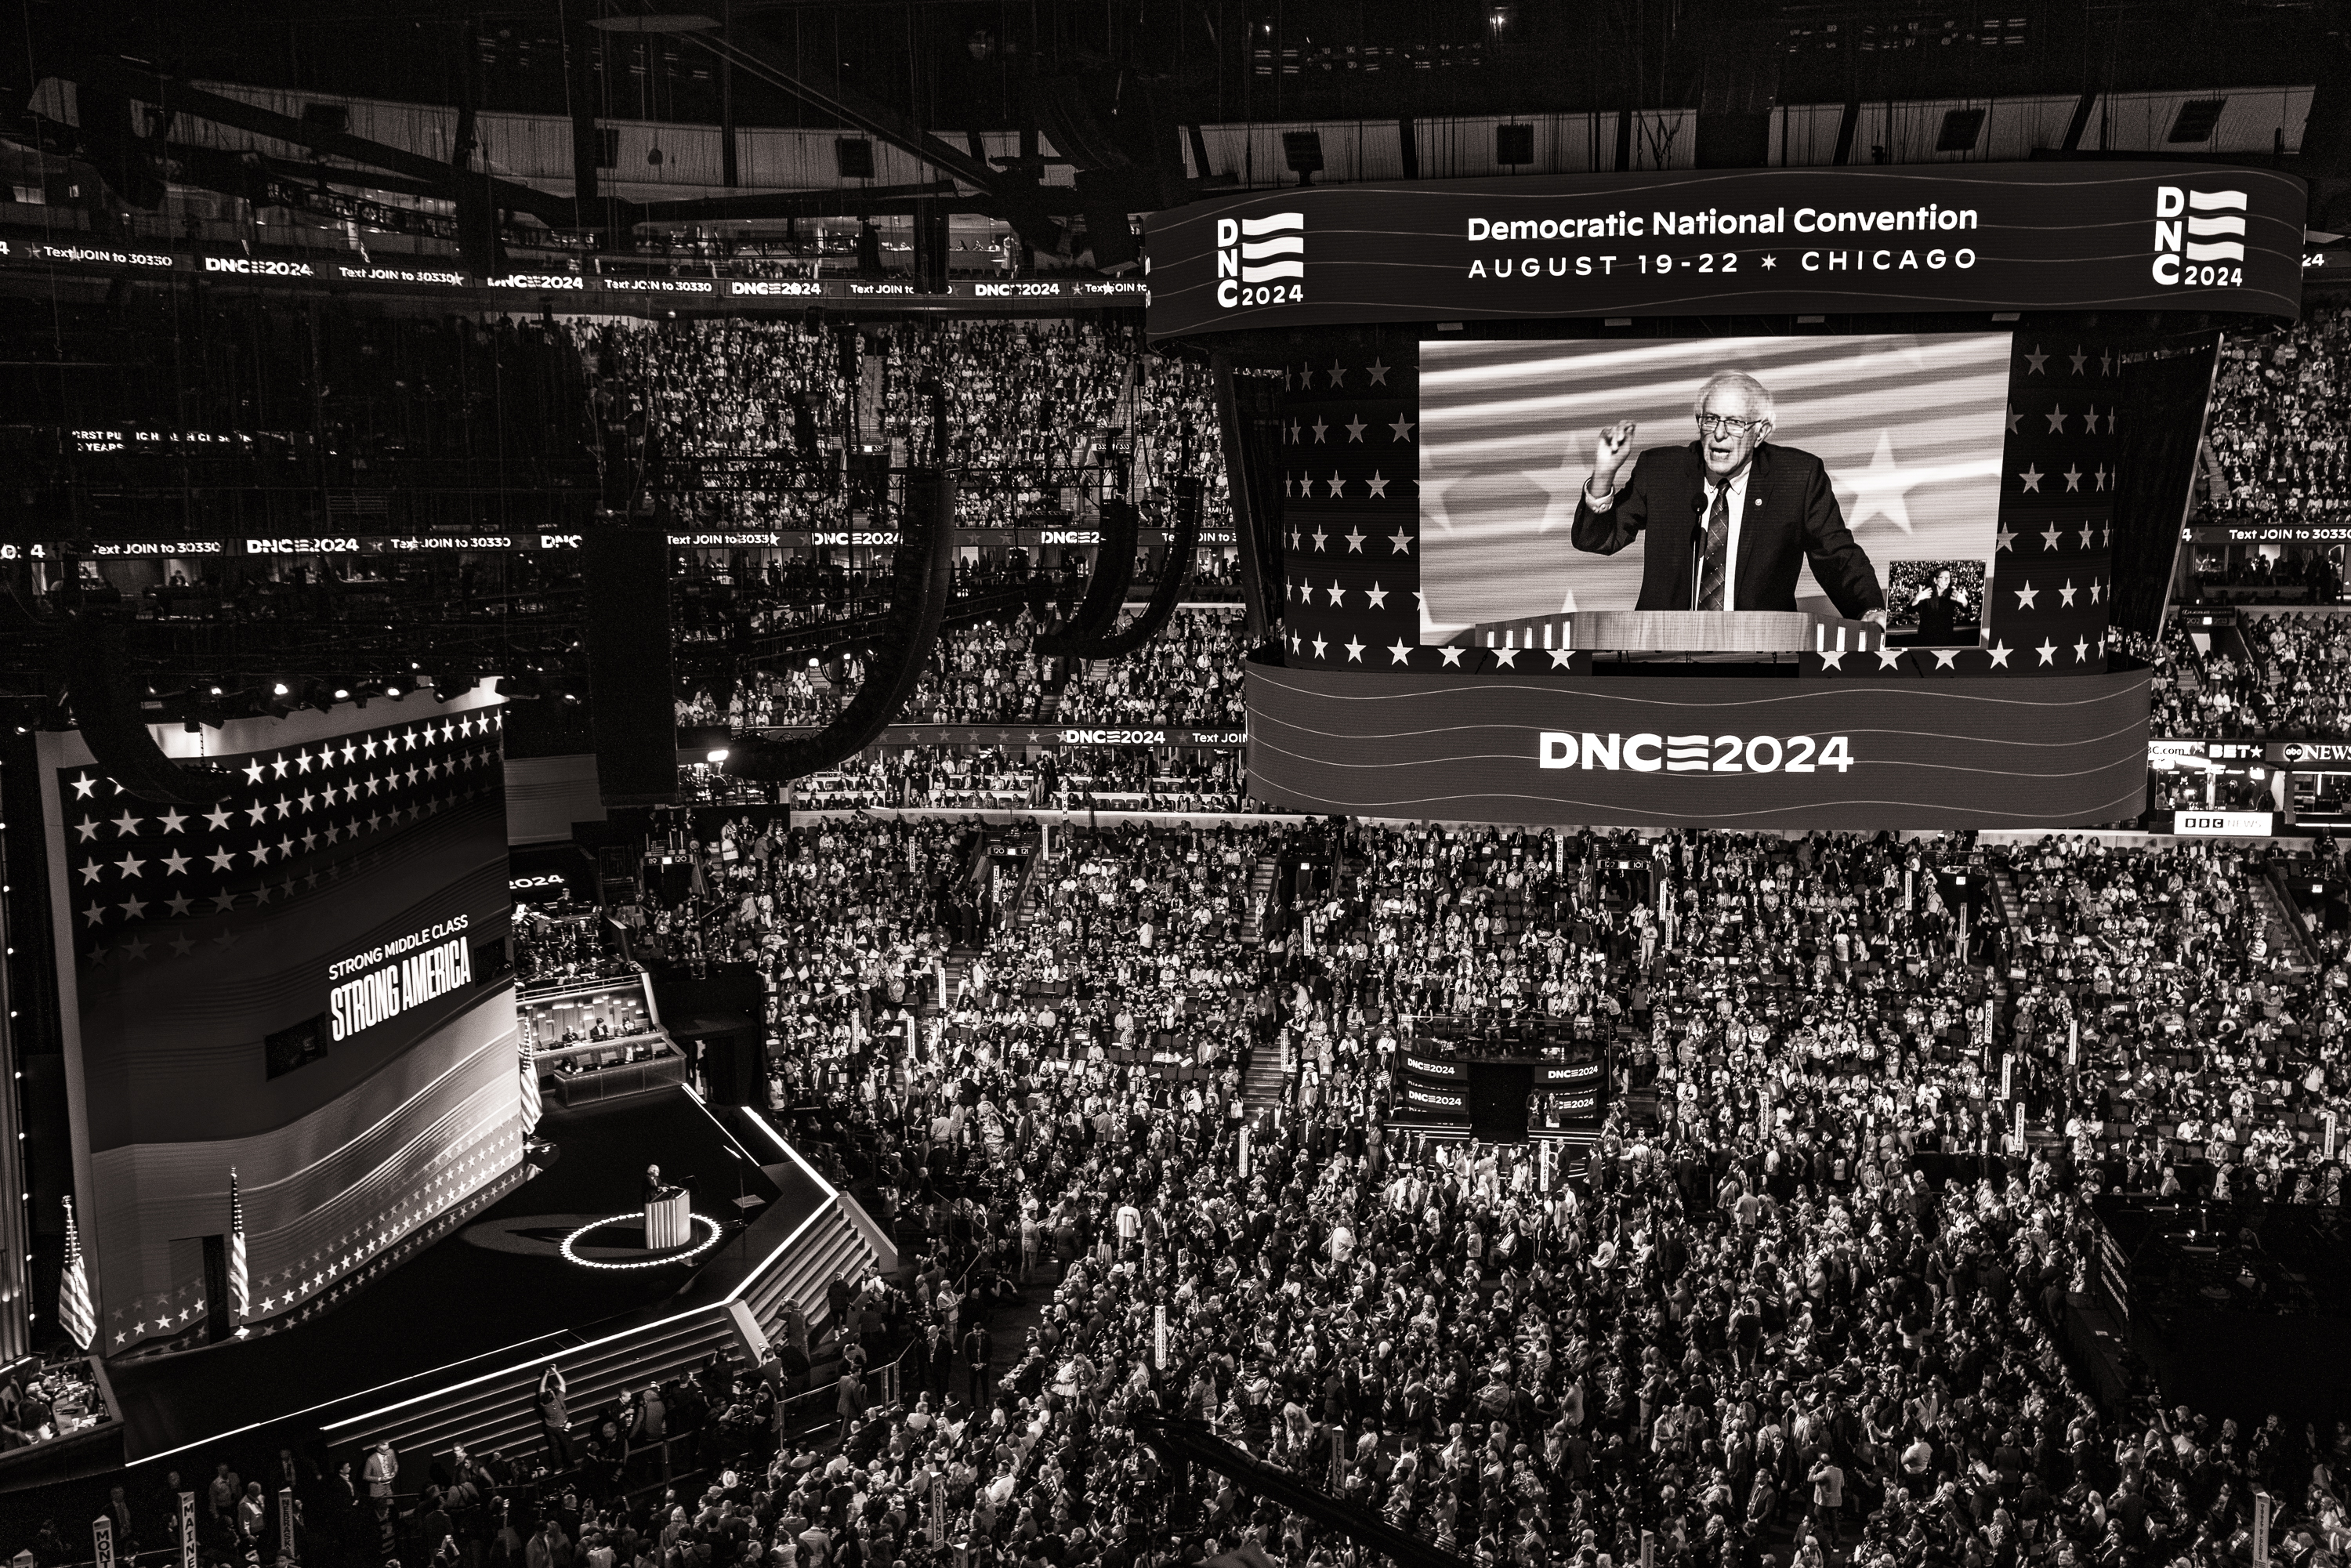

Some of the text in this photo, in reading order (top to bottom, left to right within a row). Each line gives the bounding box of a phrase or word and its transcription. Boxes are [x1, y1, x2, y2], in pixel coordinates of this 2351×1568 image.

[1469, 204, 1977, 241] Democratic National Convention
[113, 252, 127, 263] to
[1469, 249, 1975, 278] AUGUST 19-22 CHICAGO
[339, 267, 367, 278] Text
[368, 270, 399, 280] JOIN
[401, 272, 415, 281] to
[2186, 266, 2242, 286] 2024
[604, 279, 630, 289] Text
[661, 281, 674, 292] to
[676, 281, 712, 292] 30330
[850, 284, 875, 295] Text
[875, 284, 903, 295] JOIN
[1242, 281, 1303, 306] 2024
[692, 535, 723, 545] JOIN
[725, 535, 737, 545] to
[1218, 533, 1230, 542] to
[2229, 529, 2257, 540] Text
[2259, 529, 2293, 540] JOIN
[2295, 529, 2310, 540] to
[123, 543, 158, 554] JOIN
[161, 543, 175, 553] to
[455, 538, 468, 548] to
[1192, 733, 1219, 743] Text
[2209, 744, 2251, 759] BET
[2186, 818, 2224, 828] BBC
[329, 914, 469, 980] STRONG MIDDLE CLASS
[330, 936, 471, 1042] STRONG AMERICA
[1863, 1048, 1874, 1058] 24
[933, 1481, 942, 1541] MARYLAND
[184, 1502, 195, 1568] MAINE
